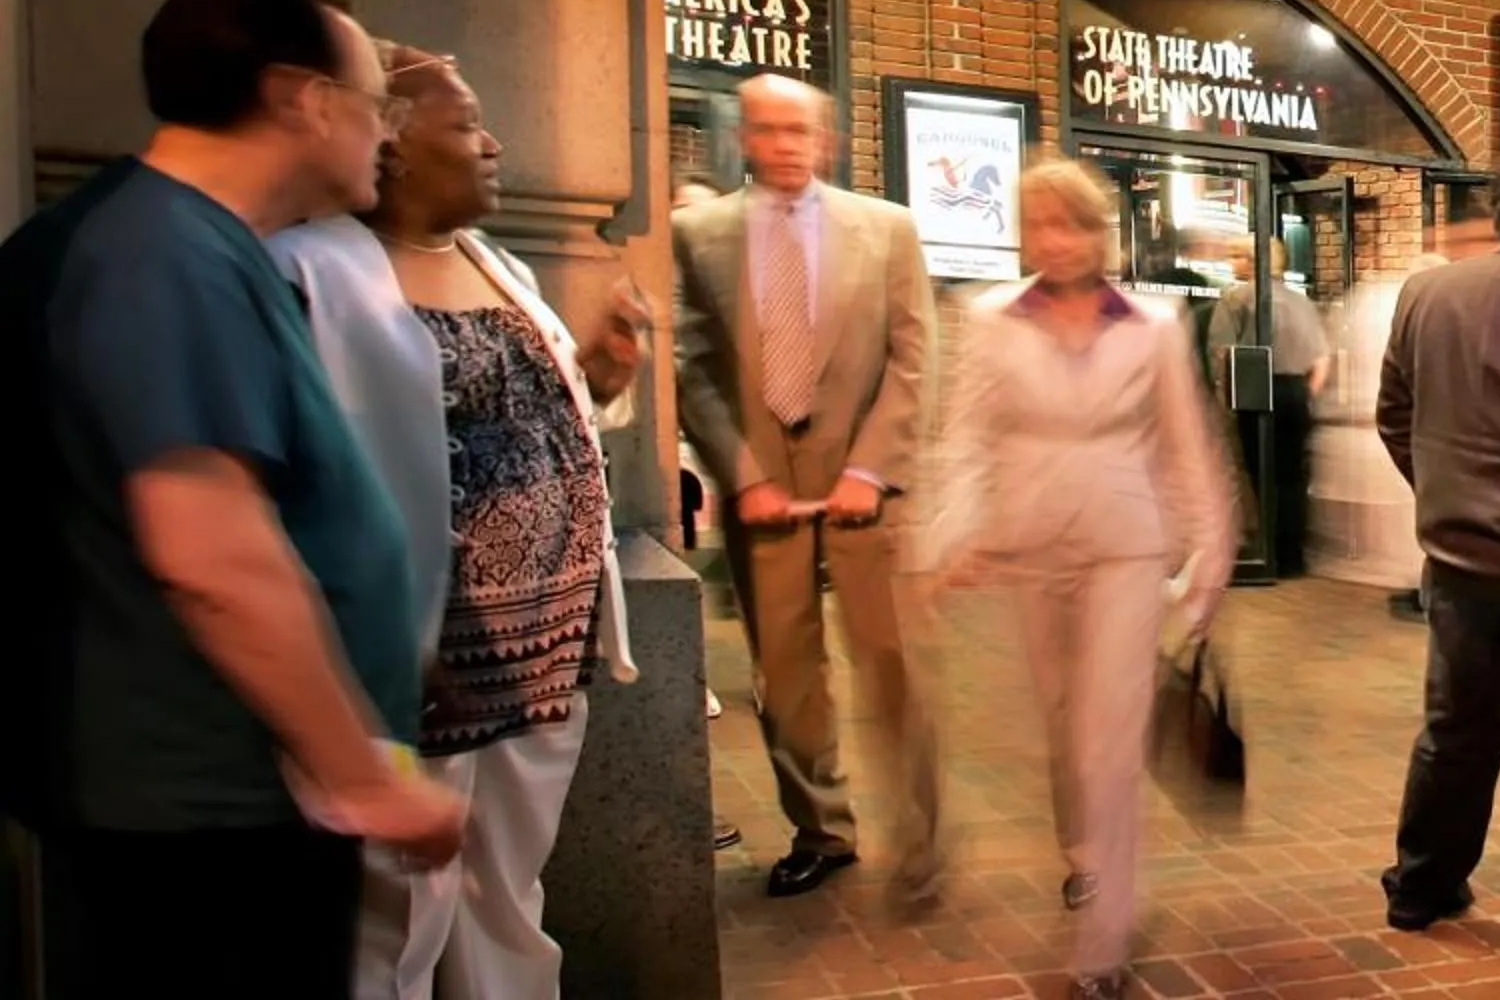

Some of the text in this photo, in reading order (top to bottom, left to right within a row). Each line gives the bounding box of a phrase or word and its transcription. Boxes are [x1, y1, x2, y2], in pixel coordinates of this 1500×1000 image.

[1156, 35, 1254, 81] THEATRE
[1084, 69, 1318, 131] OF PENNSYLVANIA
